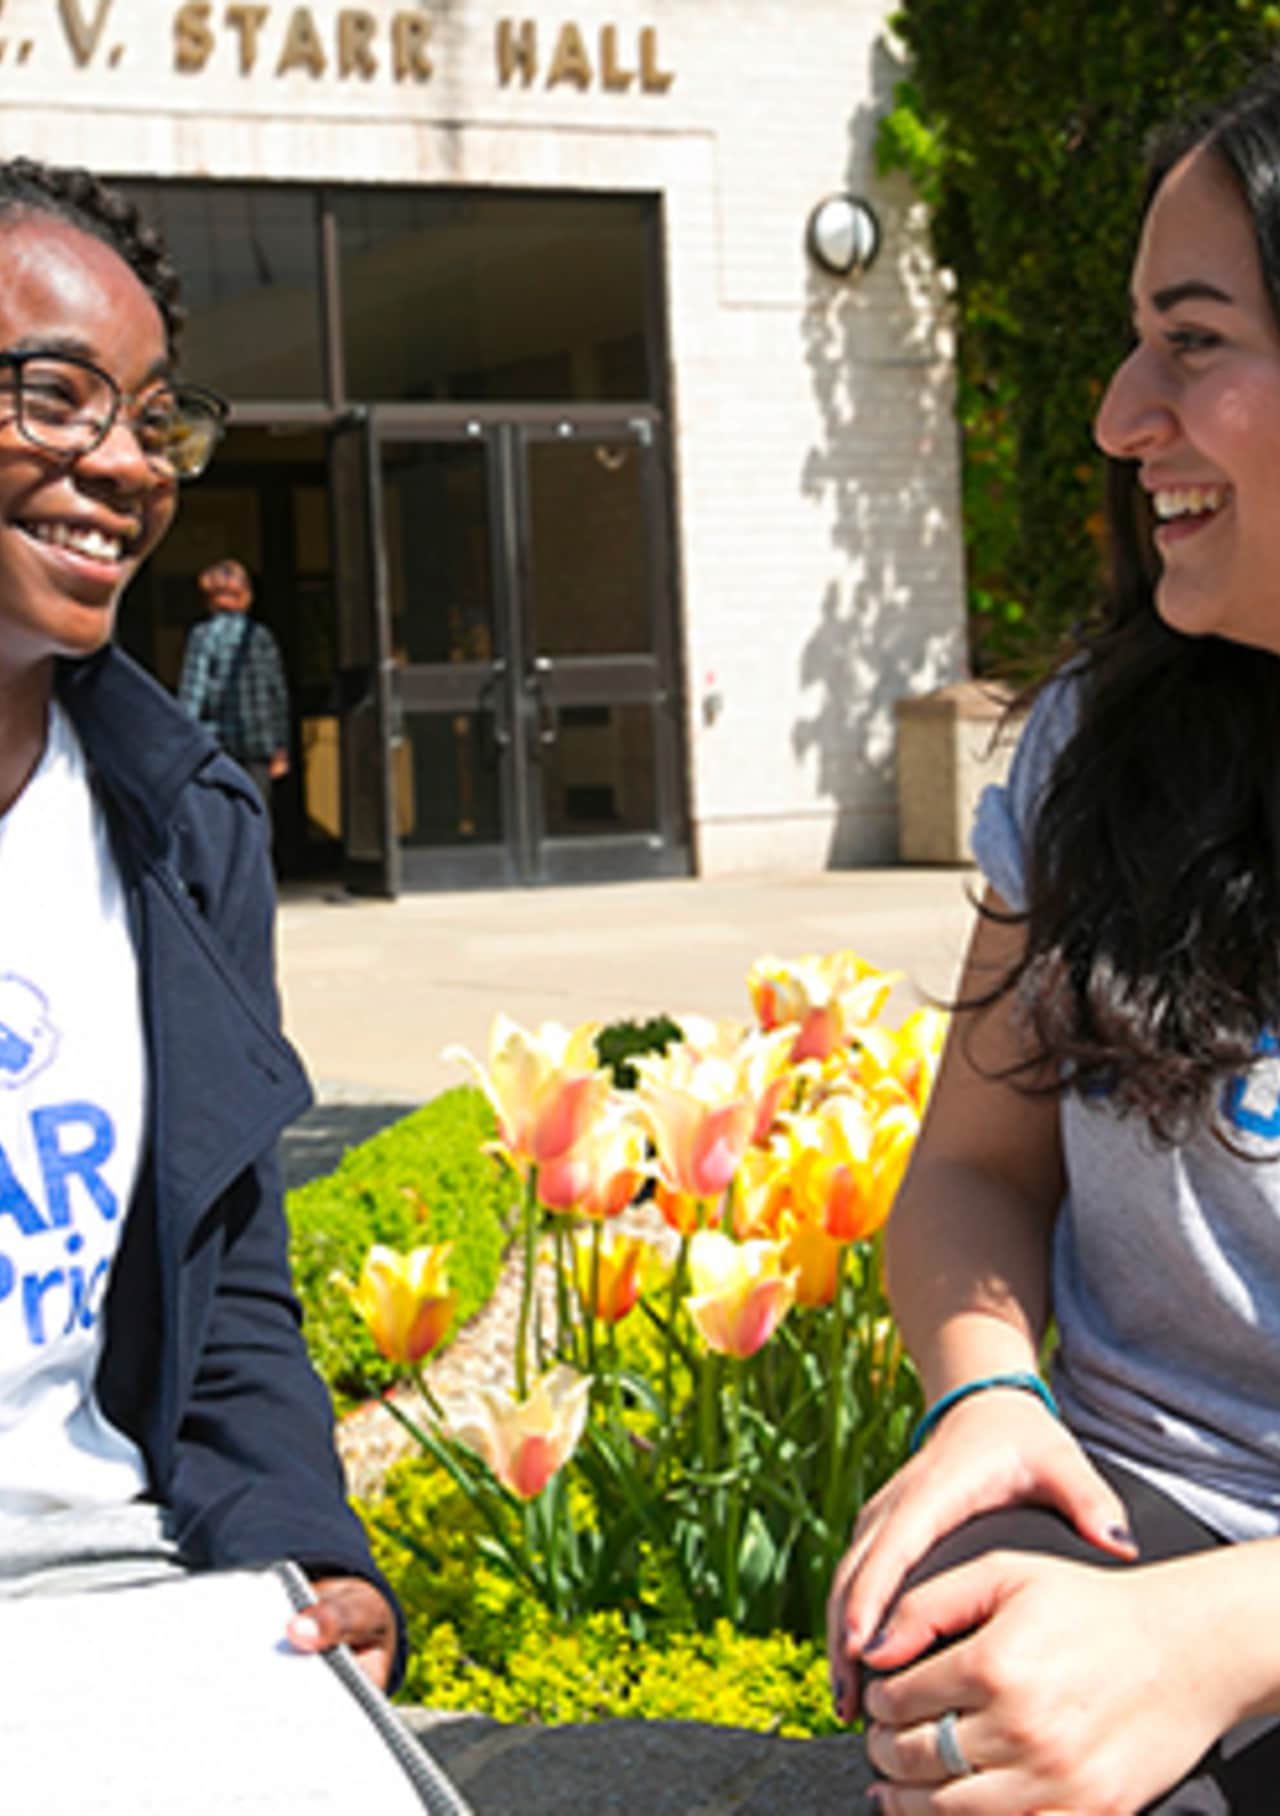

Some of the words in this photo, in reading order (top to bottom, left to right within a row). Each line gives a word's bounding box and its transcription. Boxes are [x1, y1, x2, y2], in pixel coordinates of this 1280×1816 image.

[57, 0, 123, 70] V.
[173, 2, 433, 84] STARR
[496, 18, 676, 94] HALL
